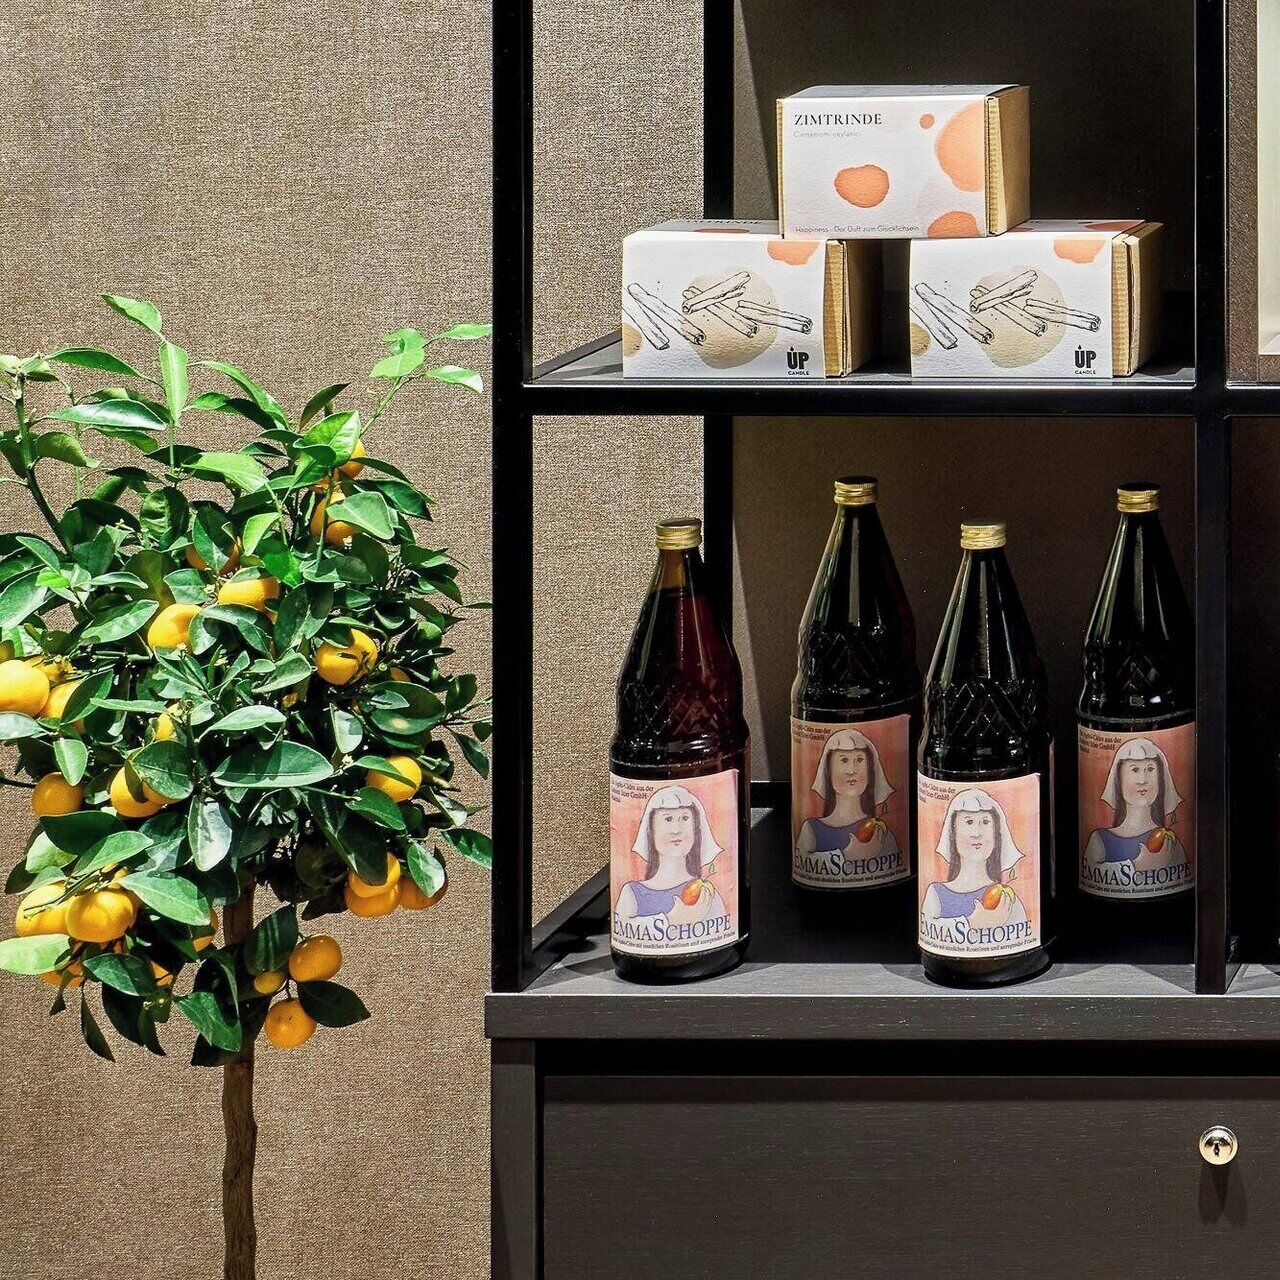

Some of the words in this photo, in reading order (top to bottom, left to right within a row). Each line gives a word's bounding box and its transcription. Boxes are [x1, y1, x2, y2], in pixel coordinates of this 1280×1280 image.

[794, 113, 882, 125] ZIMTRINDE
[787, 351, 810, 370] UP
[1074, 350, 1097, 368] UP
